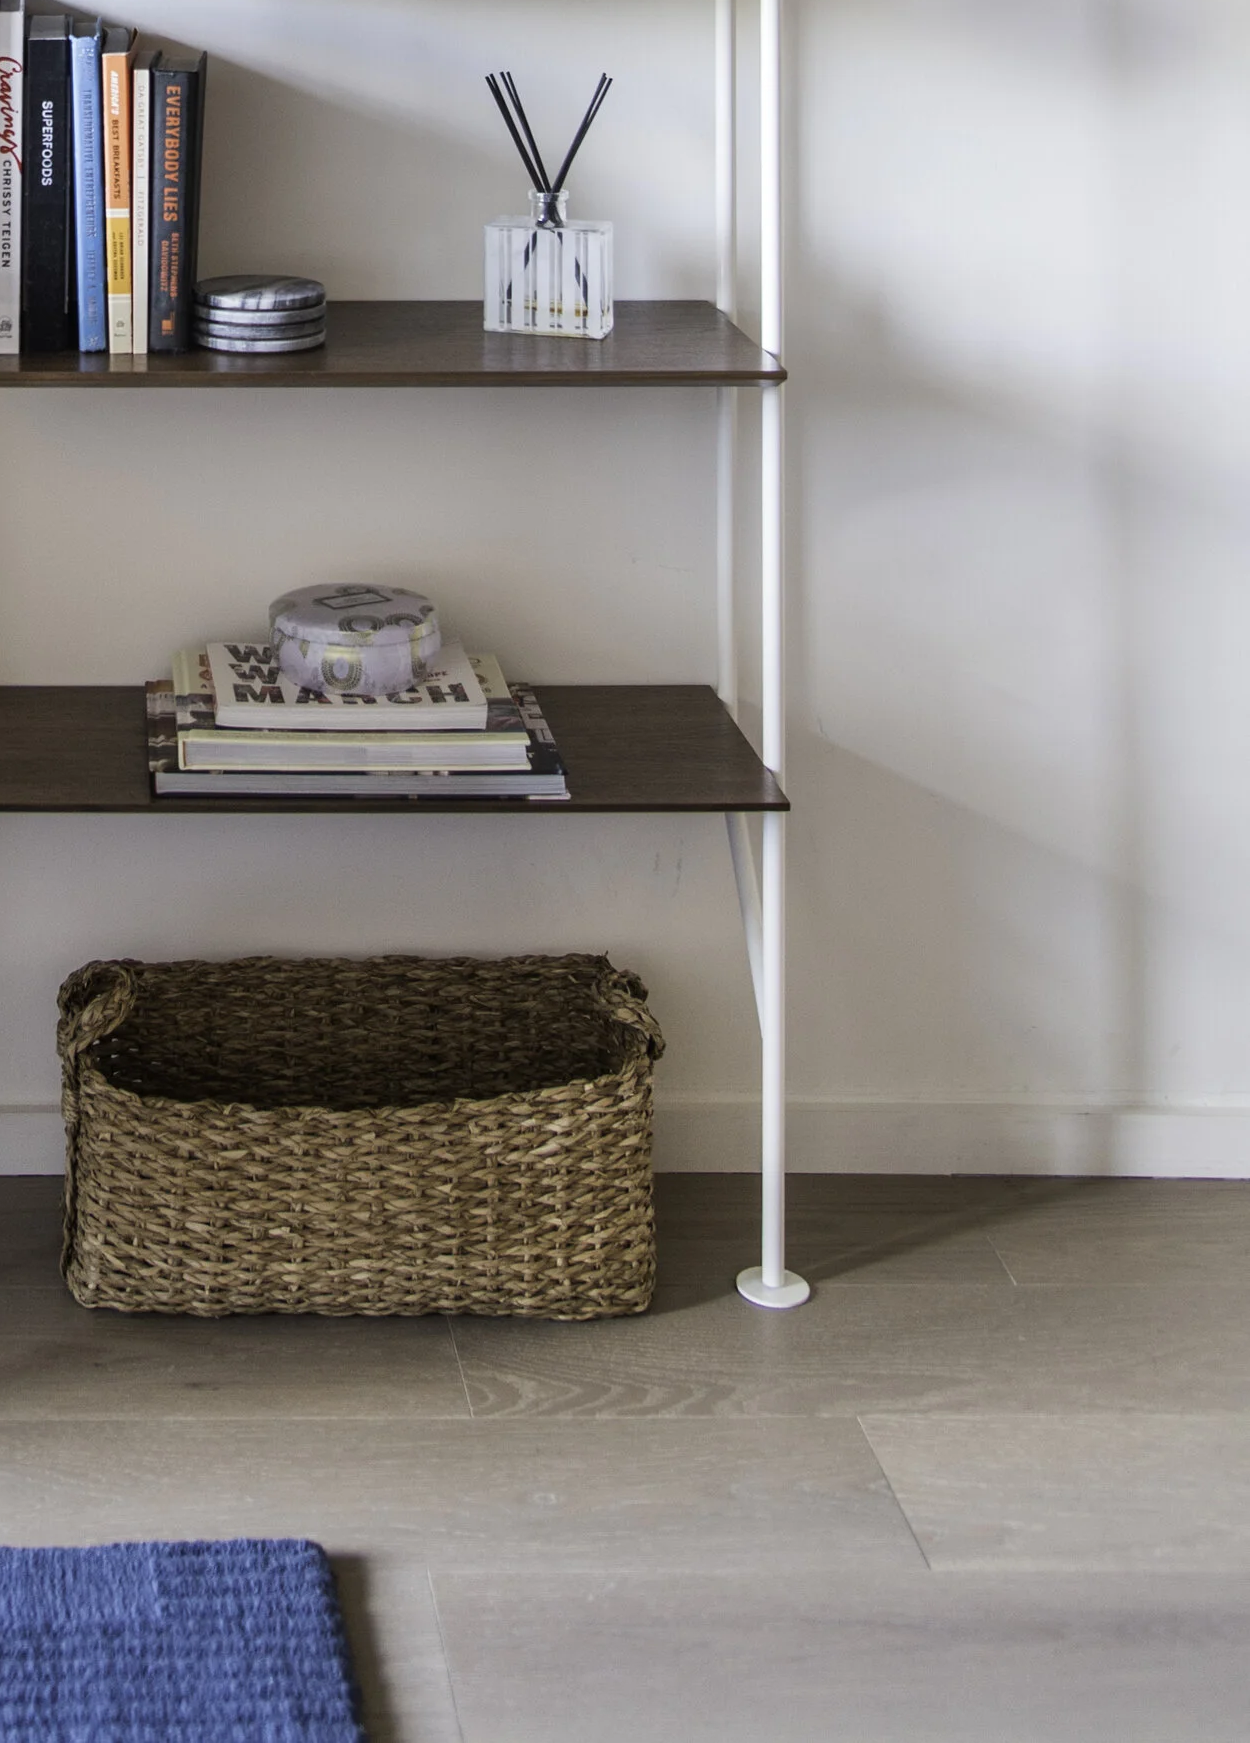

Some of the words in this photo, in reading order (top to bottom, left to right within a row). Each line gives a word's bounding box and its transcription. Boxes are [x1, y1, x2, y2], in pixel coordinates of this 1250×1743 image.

[111, 119, 120, 142] BEST
[137, 101, 145, 131] GREAT
[164, 85, 181, 183] EVERYBODY
[41, 100, 54, 187] SUPERFOODS
[137, 134, 145, 169] GATSBY
[1, 159, 12, 216] CHRISSY
[112, 145, 121, 200] BREAKFASTS
[137, 191, 145, 247] FITZGERALD
[163, 187, 179, 222] LIES
[1, 222, 12, 268] TEIGEN
[160, 240, 169, 293] DAVIDOWITZ
[171, 232, 180, 254] SETH
